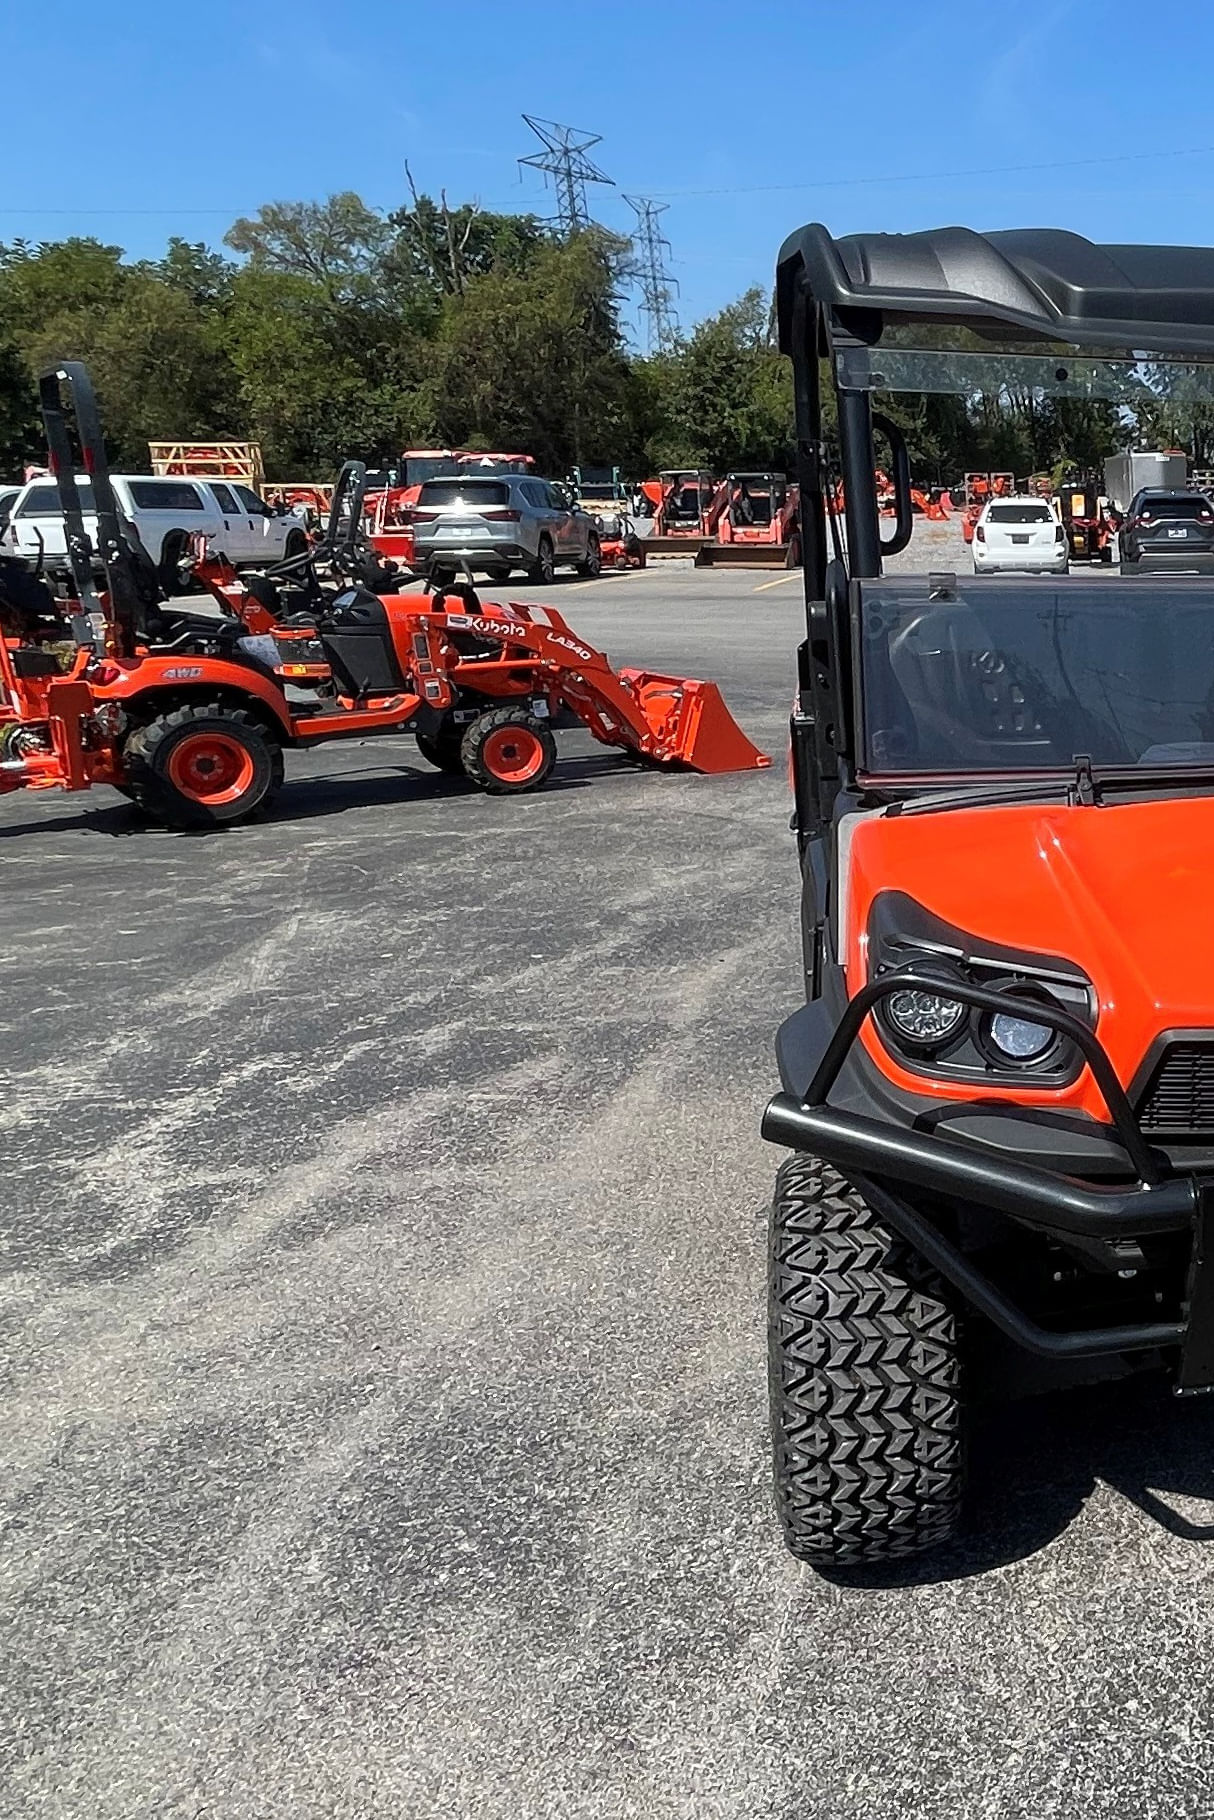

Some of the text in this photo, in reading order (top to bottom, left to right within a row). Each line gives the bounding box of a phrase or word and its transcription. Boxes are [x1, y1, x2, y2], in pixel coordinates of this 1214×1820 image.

[471, 617, 526, 637] Kubota
[546, 632, 592, 661] LA340
[162, 666, 203, 680] 4WD
